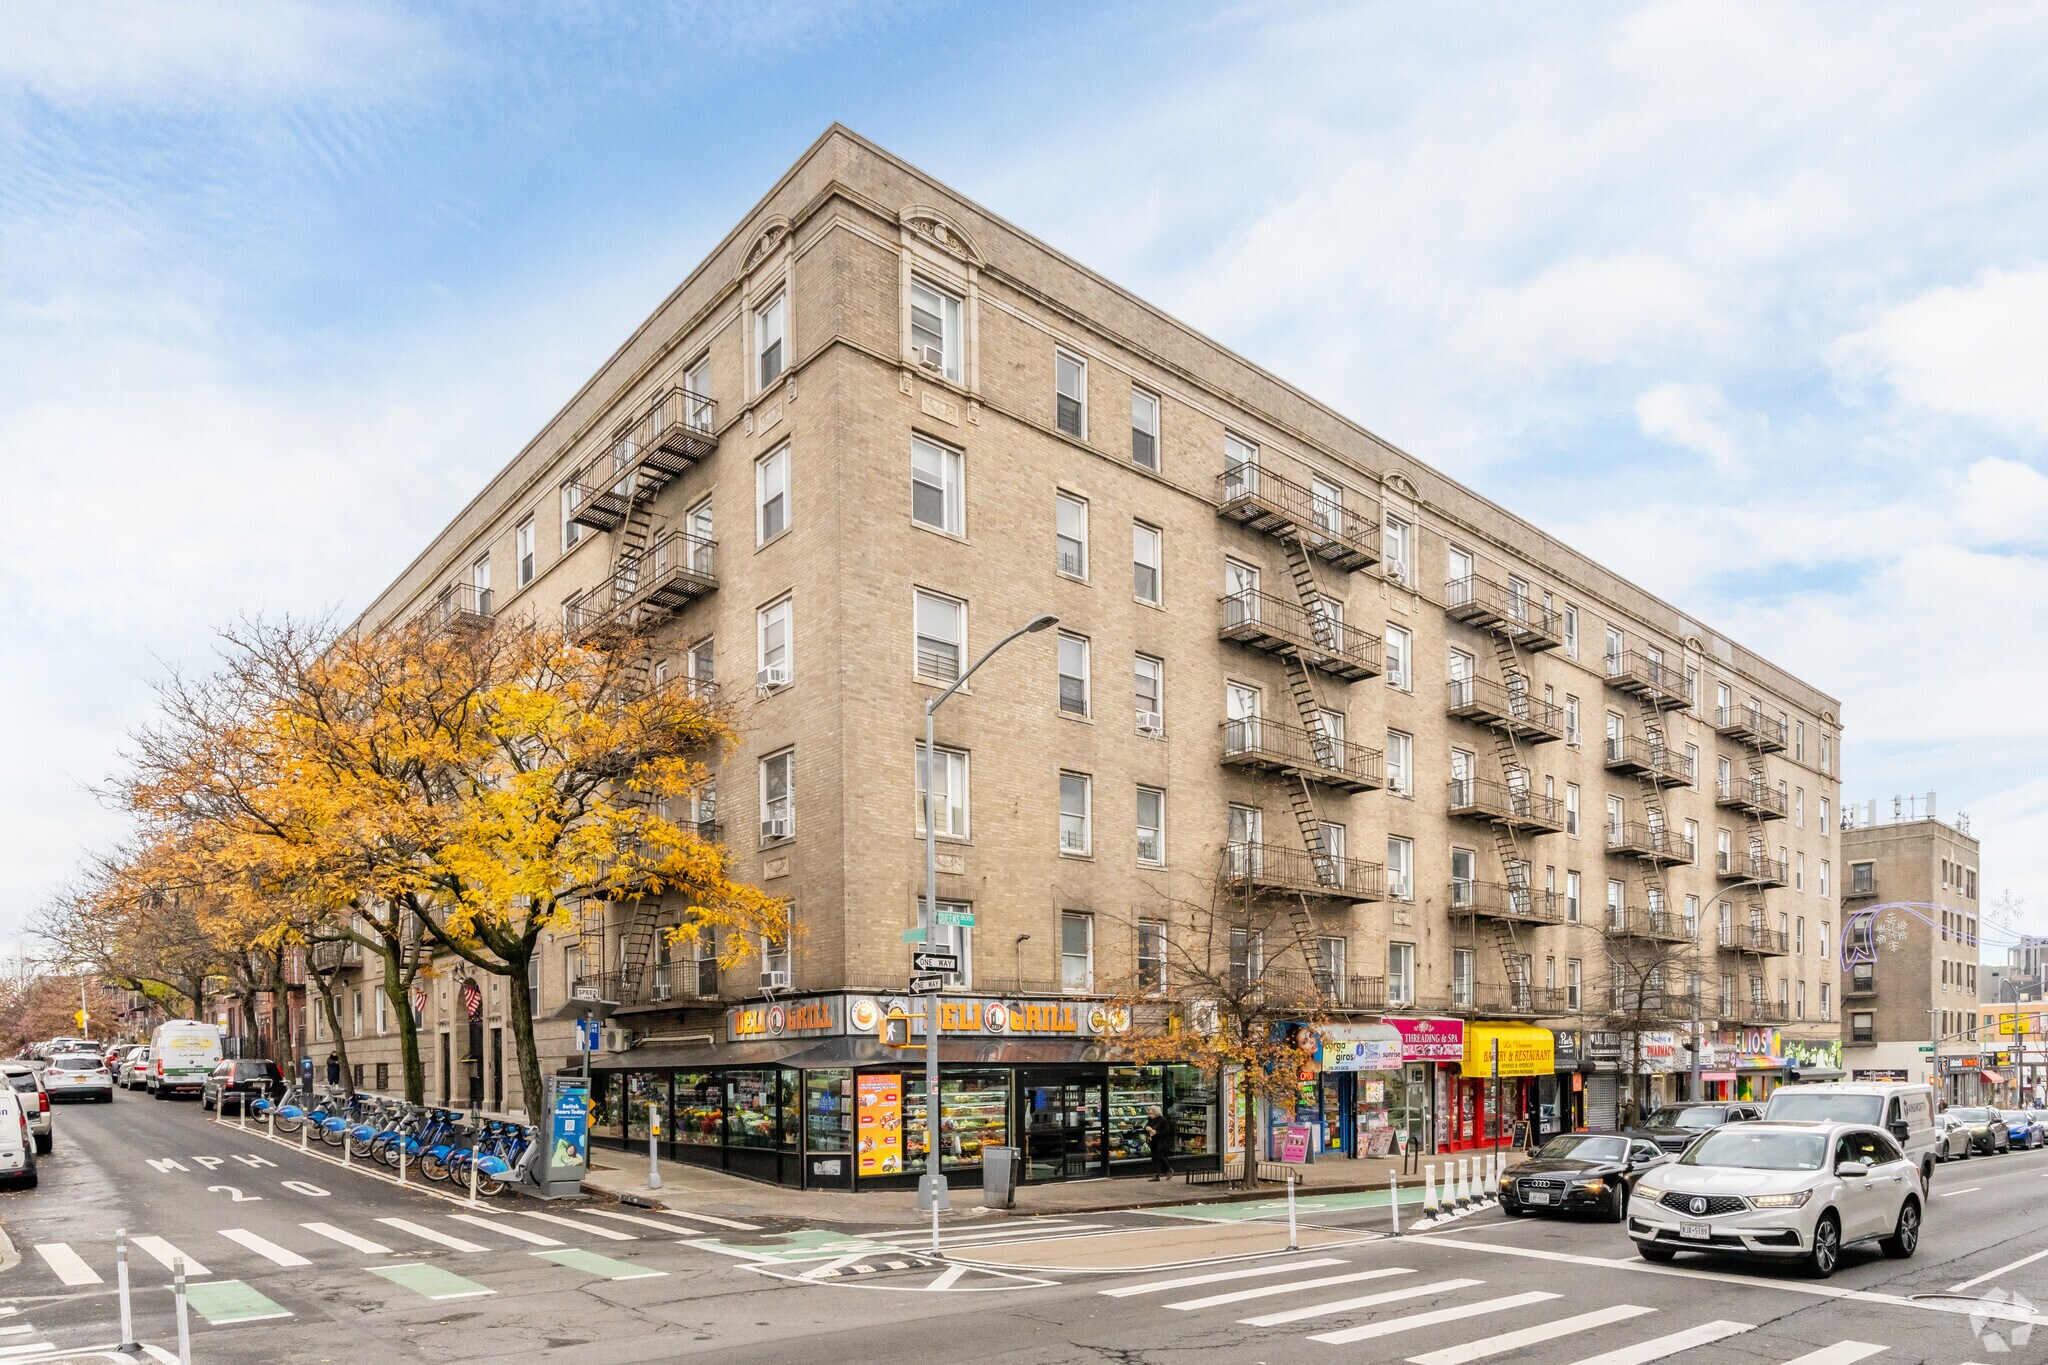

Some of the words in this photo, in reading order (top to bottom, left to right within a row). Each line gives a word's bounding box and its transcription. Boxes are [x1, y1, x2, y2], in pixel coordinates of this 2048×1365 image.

[938, 911, 960, 925] QUEENS
[960, 913, 973, 921] BLVD
[920, 958, 933, 966] ONE
[938, 959, 953, 968] WAY
[914, 981, 924, 990] ONE
[928, 980, 940, 988] WAY
[734, 1010, 766, 1035] DELI
[786, 1004, 833, 1031] GRILL
[1009, 1003, 1077, 1032] GRILL
[1404, 1033, 1440, 1043] THREADING
[1440, 1034, 1447, 1043] &
[1447, 1033, 1458, 1043] SPA
[1335, 1051, 1354, 1064] giros
[1483, 1050, 1508, 1063] BARY
[1515, 1050, 1551, 1061] RESTAURANT
[571, 1108, 587, 1116] Today
[144, 1154, 279, 1173] MPH
